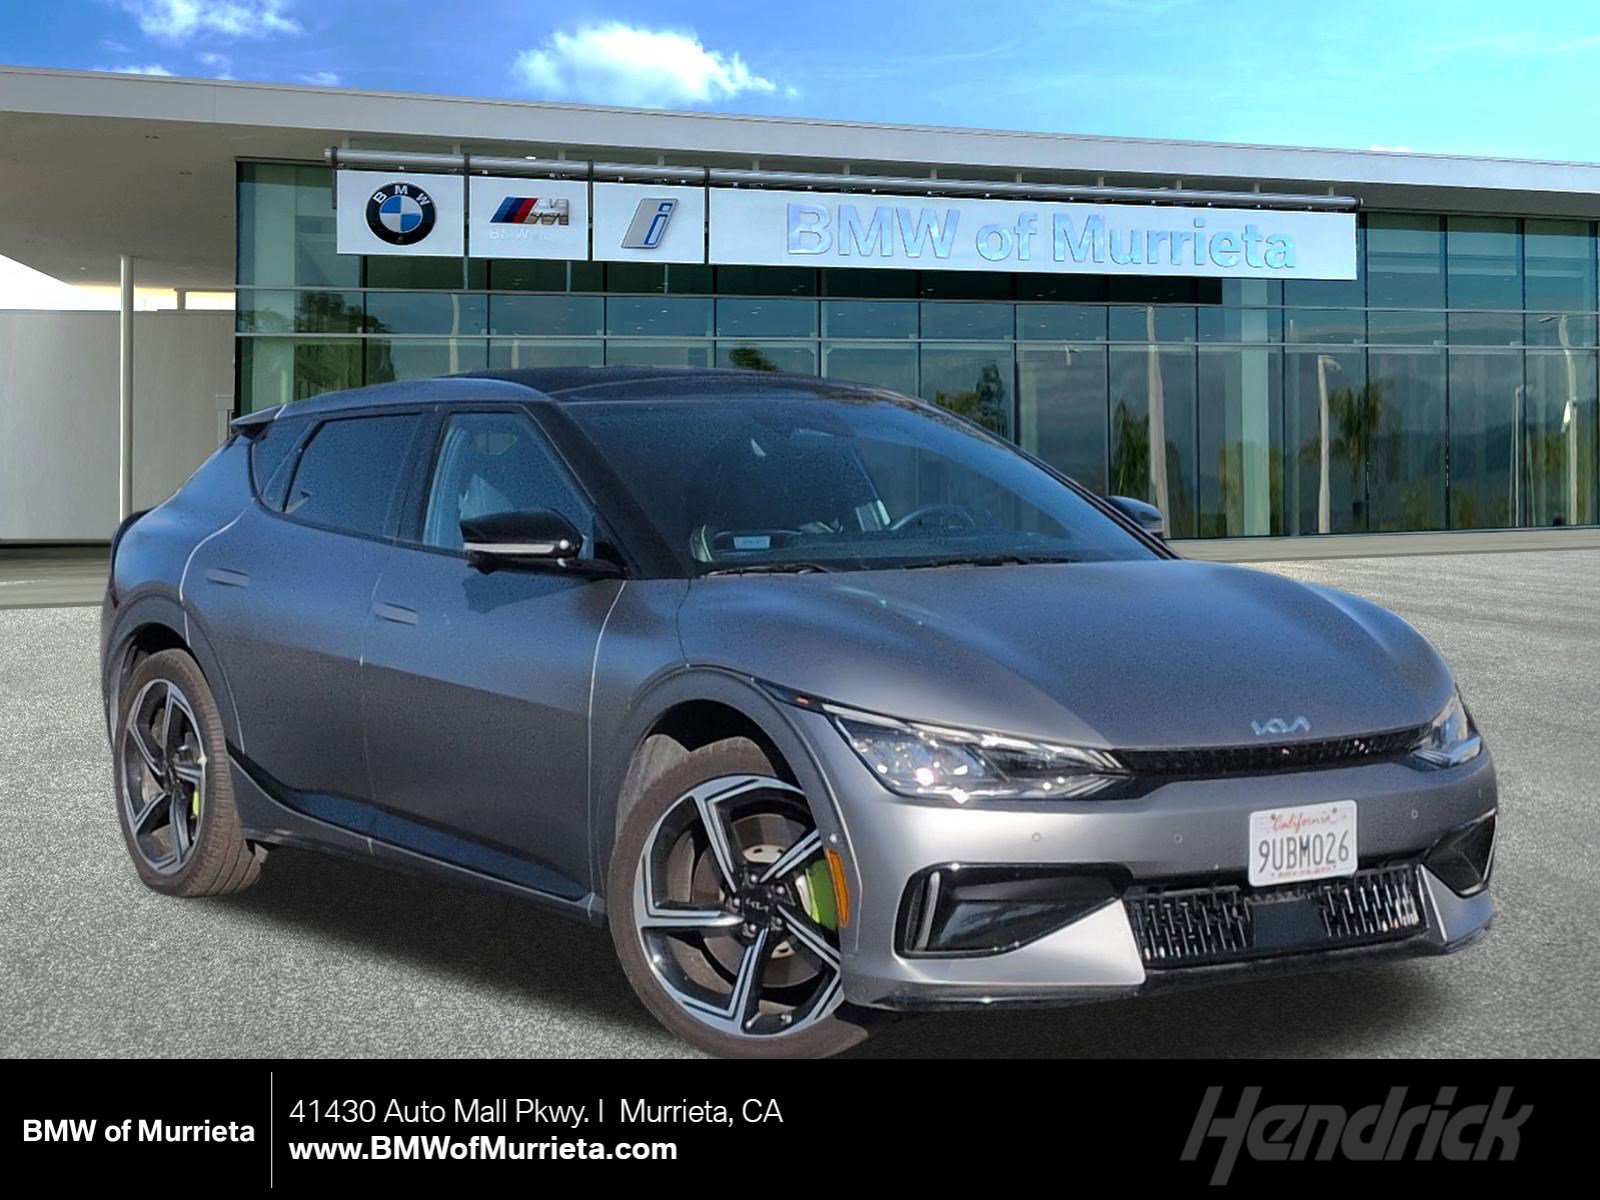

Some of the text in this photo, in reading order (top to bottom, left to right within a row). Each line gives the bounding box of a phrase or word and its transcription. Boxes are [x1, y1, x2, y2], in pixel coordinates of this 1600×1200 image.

[372, 185, 431, 206] BMW
[786, 202, 1296, 270] BMW of Murrieta
[1272, 811, 1337, 832] California
[1258, 829, 1349, 874] 9UBM026
